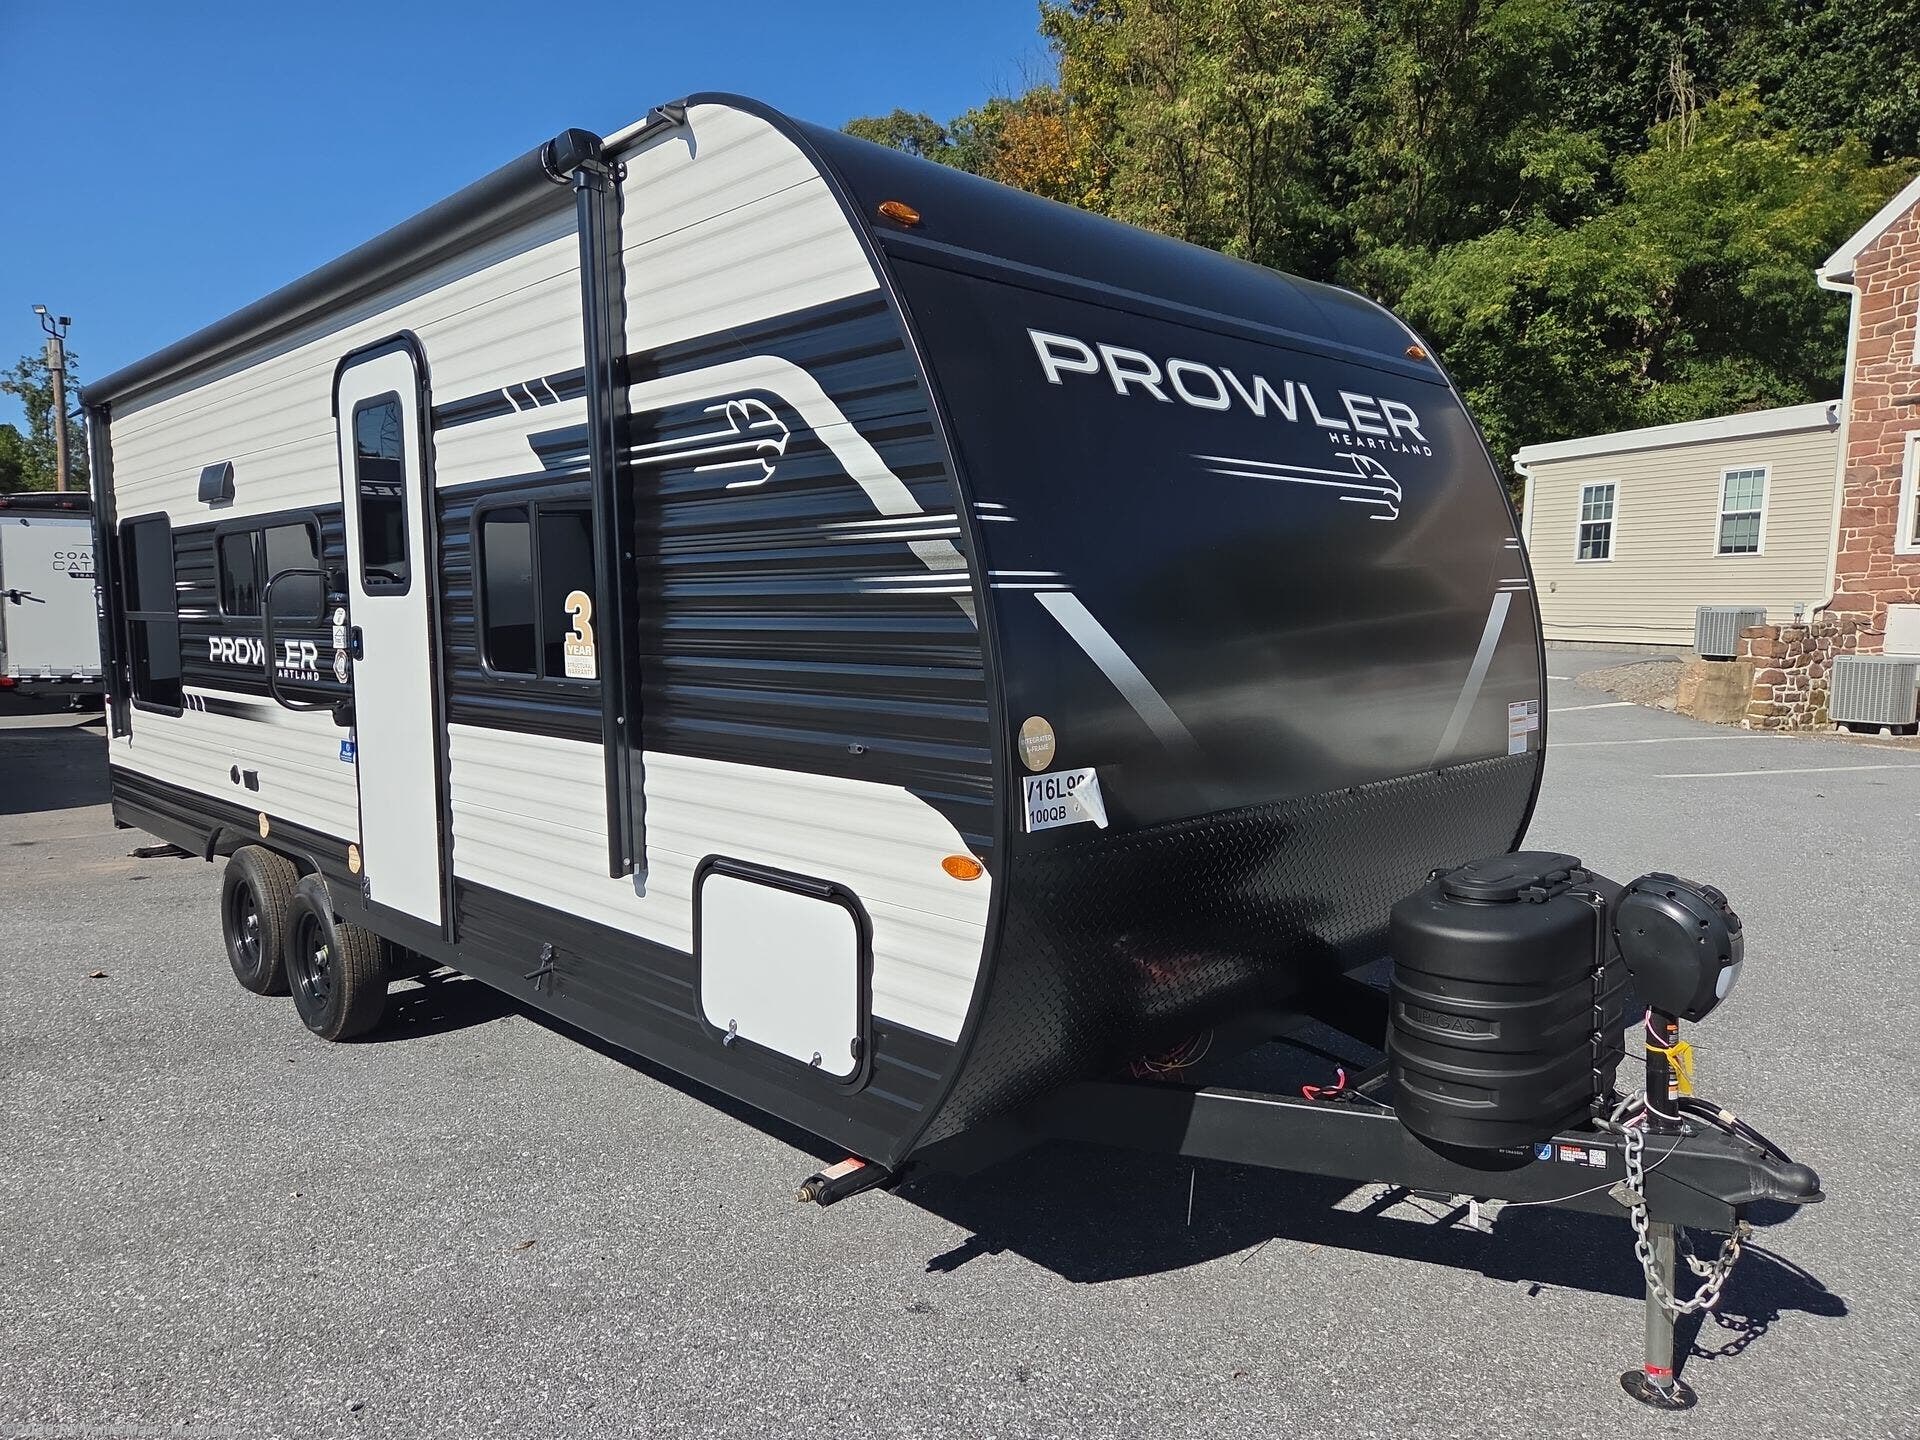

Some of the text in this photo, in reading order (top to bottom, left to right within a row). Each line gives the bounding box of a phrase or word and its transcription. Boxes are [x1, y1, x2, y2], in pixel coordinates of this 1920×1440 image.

[1026, 327, 1430, 443] PROWLER
[1328, 432, 1432, 458] HEARTLAND
[53, 561, 94, 571] CAT
[565, 590, 593, 645] 3
[567, 645, 592, 656] YEAR
[277, 669, 320, 682] ARTLAND
[1437, 1014, 1475, 1033] GAS
